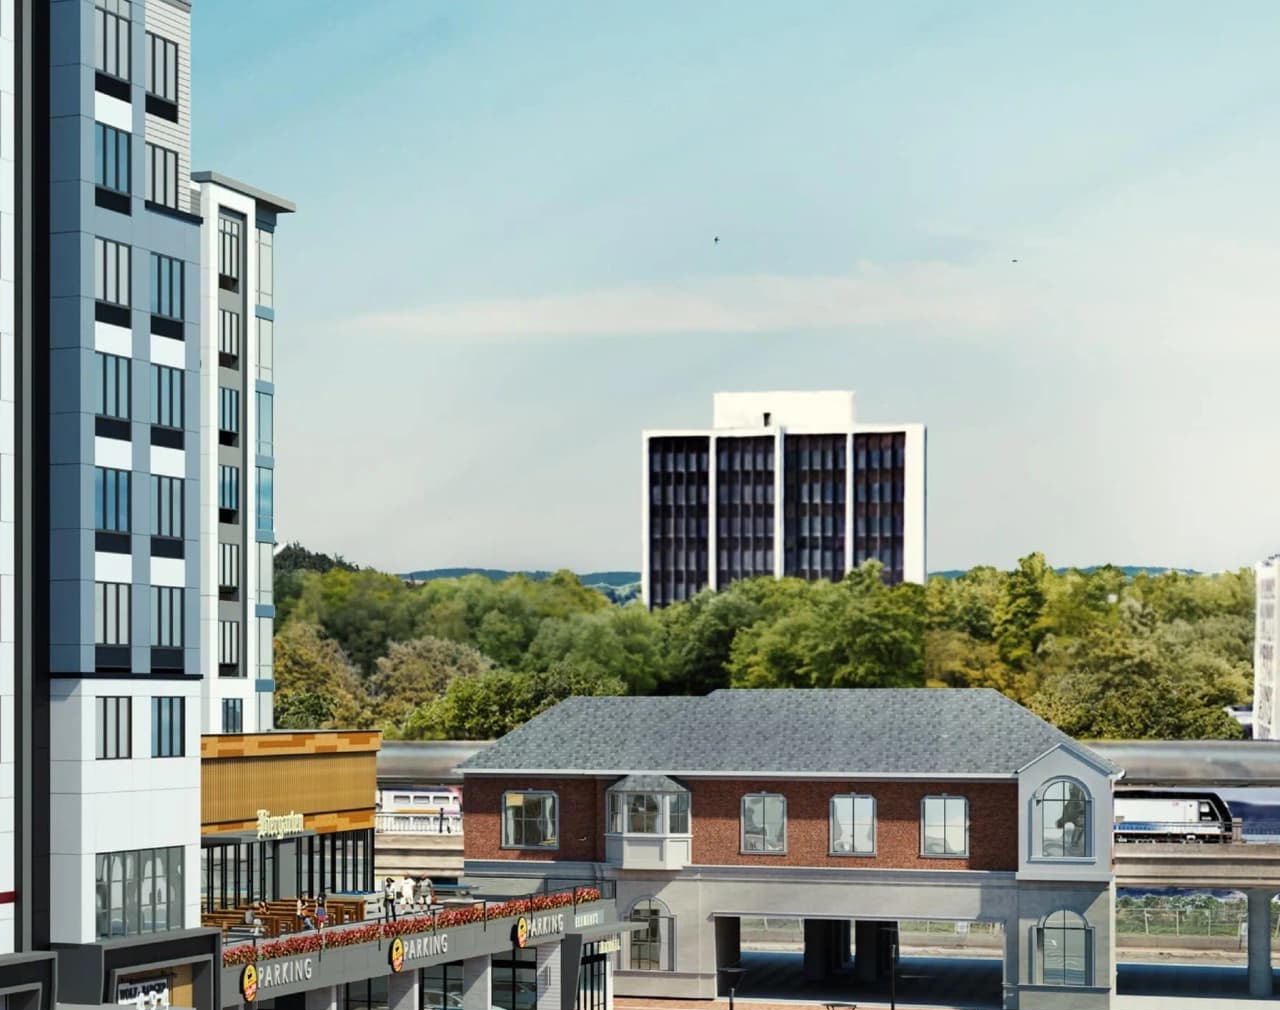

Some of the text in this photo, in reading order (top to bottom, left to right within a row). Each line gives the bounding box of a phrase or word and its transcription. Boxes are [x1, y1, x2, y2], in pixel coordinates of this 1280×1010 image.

[527, 914, 564, 938] PARKING
[404, 934, 448, 960] PARKING
[258, 958, 312, 988] PARKING
